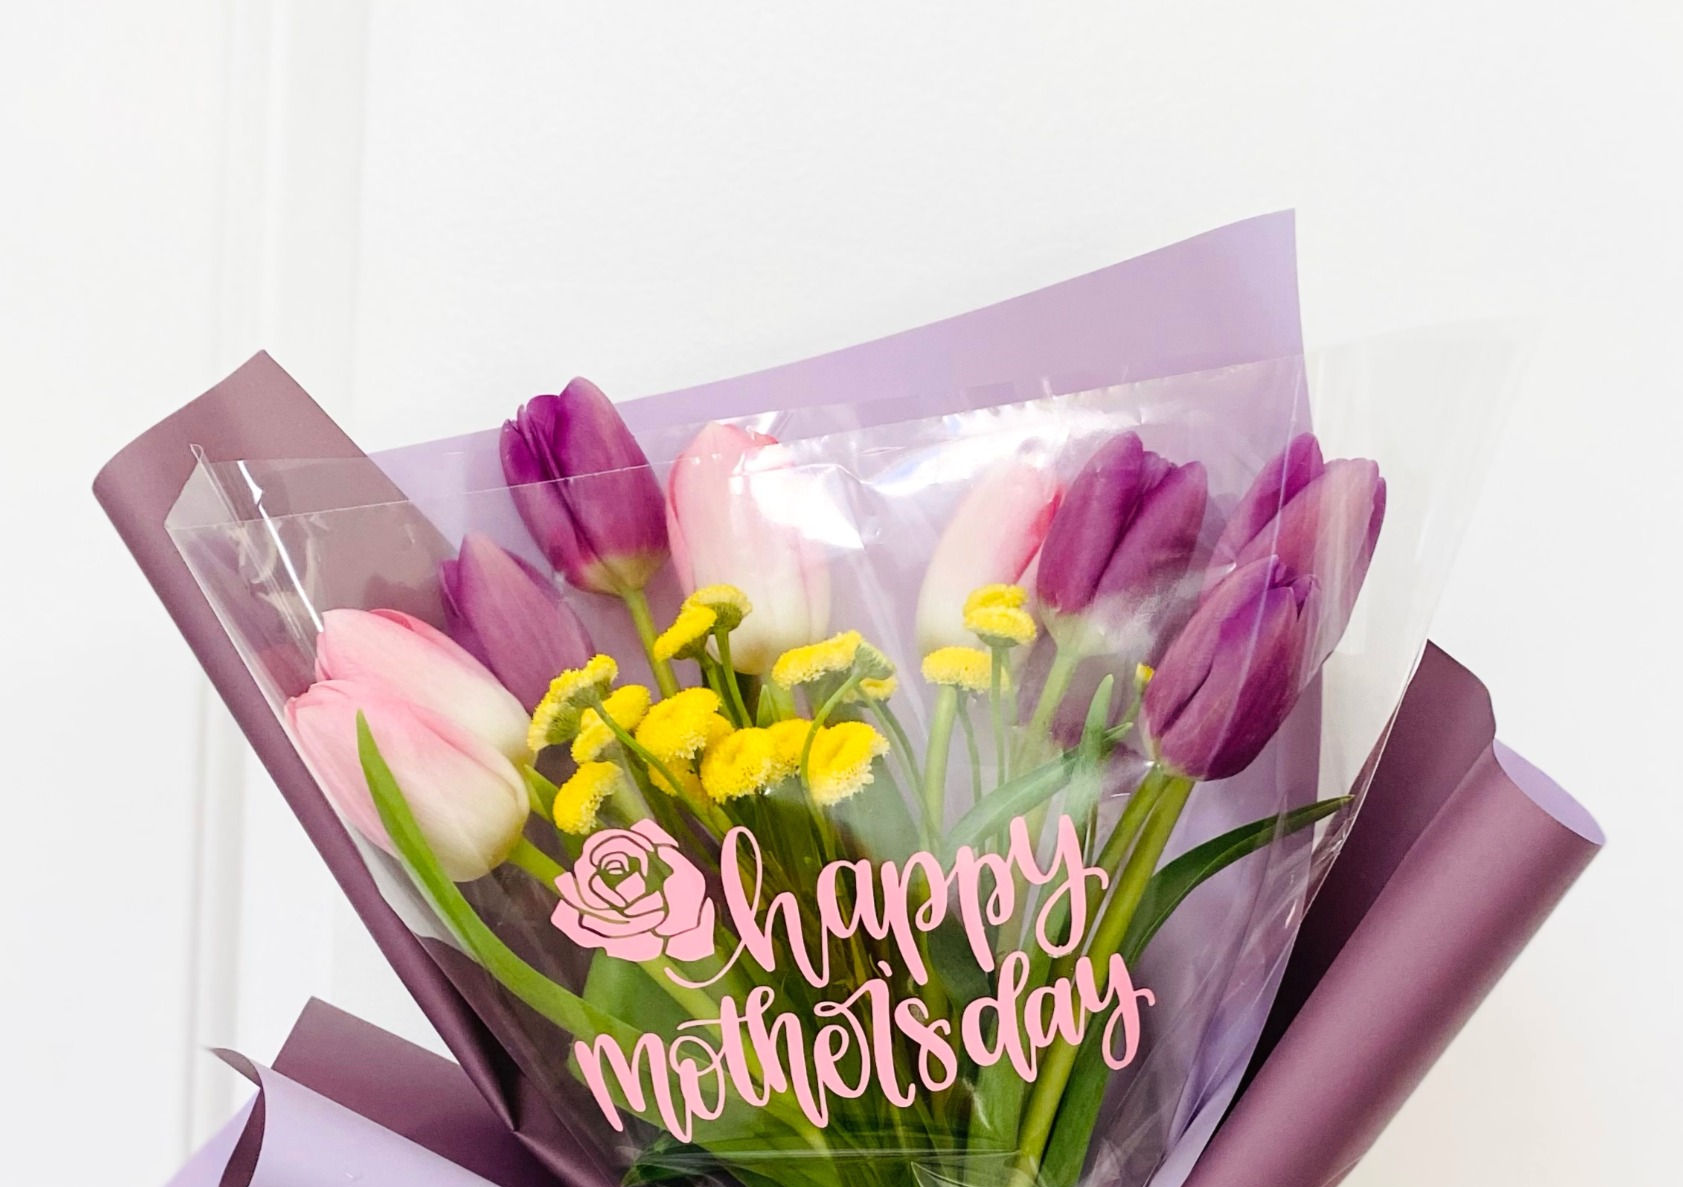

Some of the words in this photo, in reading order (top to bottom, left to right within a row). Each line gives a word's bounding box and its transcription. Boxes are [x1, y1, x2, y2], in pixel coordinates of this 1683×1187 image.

[664, 813, 1109, 989] happy
[574, 959, 958, 1144] mother's
[961, 951, 1156, 1083] day
